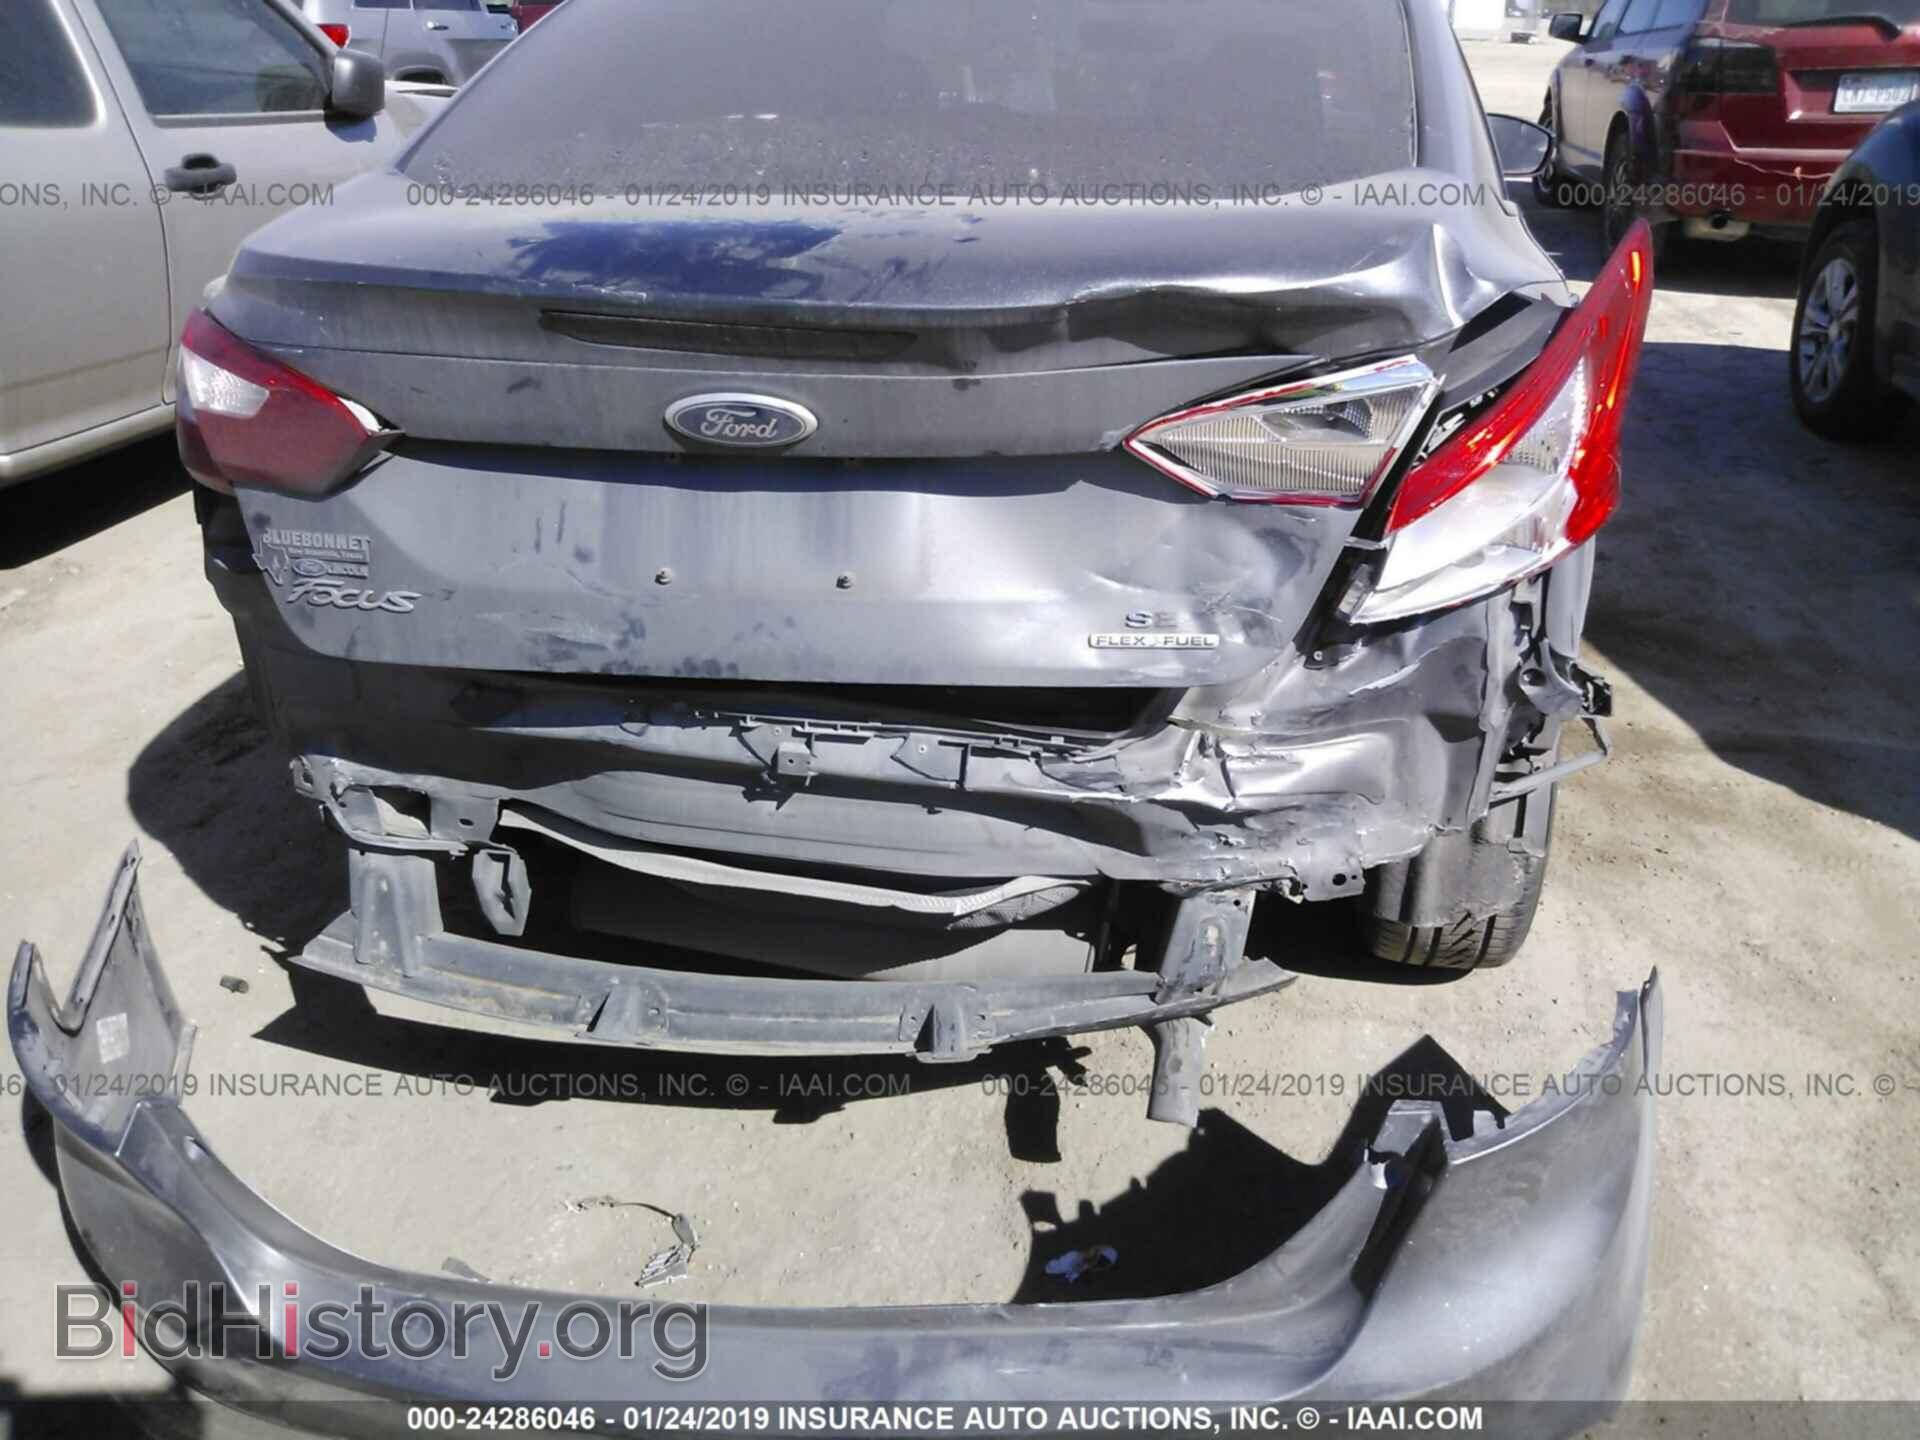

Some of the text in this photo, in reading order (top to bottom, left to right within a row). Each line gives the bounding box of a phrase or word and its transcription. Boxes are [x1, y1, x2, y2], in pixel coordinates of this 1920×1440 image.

[700, 408, 779, 438] Ford
[263, 528, 373, 551] BLUEBONNET
[1125, 608, 1178, 629] SE
[1096, 635, 1214, 647] FLEX FUEL
